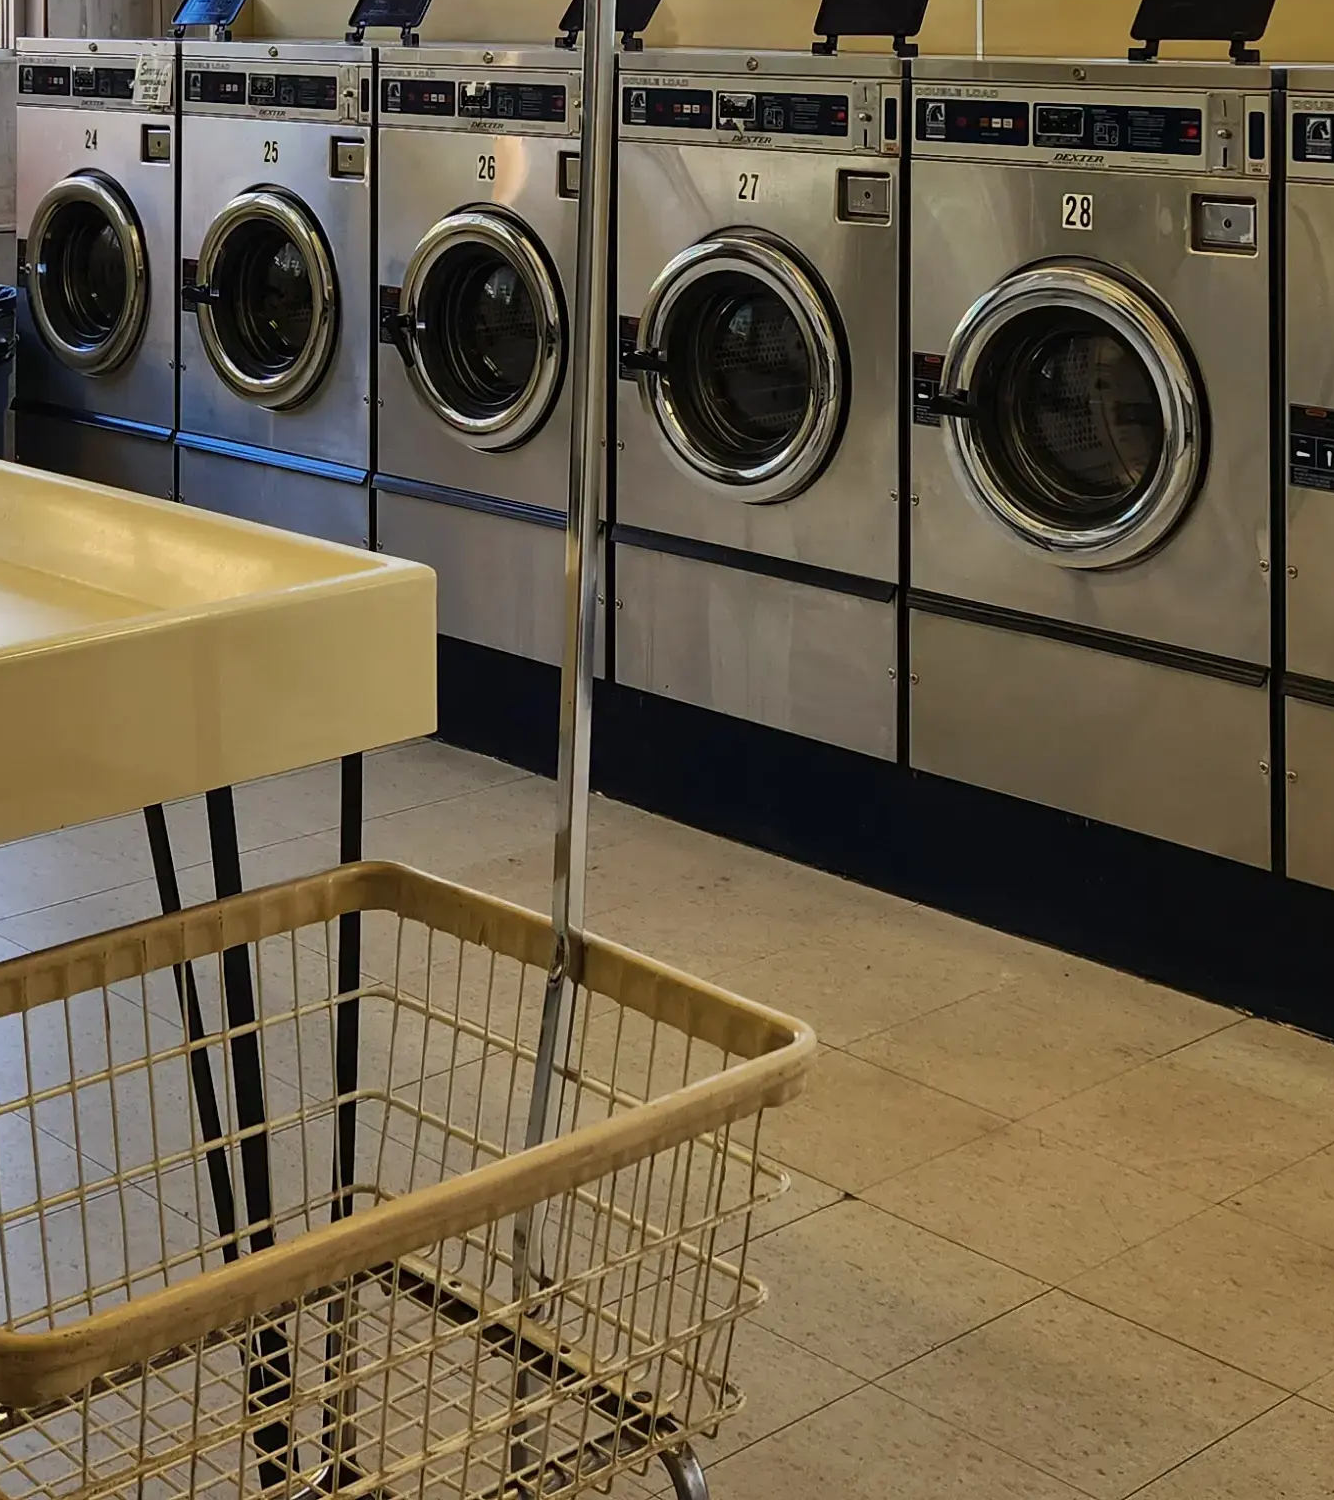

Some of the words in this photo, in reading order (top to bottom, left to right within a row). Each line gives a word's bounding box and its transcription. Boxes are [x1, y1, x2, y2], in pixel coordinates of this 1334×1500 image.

[915, 87, 962, 98] DOUBLE
[966, 89, 999, 99] LOAD
[470, 121, 505, 130] DEXTER
[85, 129, 98, 150] 24
[731, 134, 773, 145] DEXTER
[263, 140, 279, 164] 25
[1053, 153, 1105, 164] DEXTER
[478, 155, 496, 181] 26
[738, 172, 759, 201] 27
[1064, 195, 1091, 228] 28
